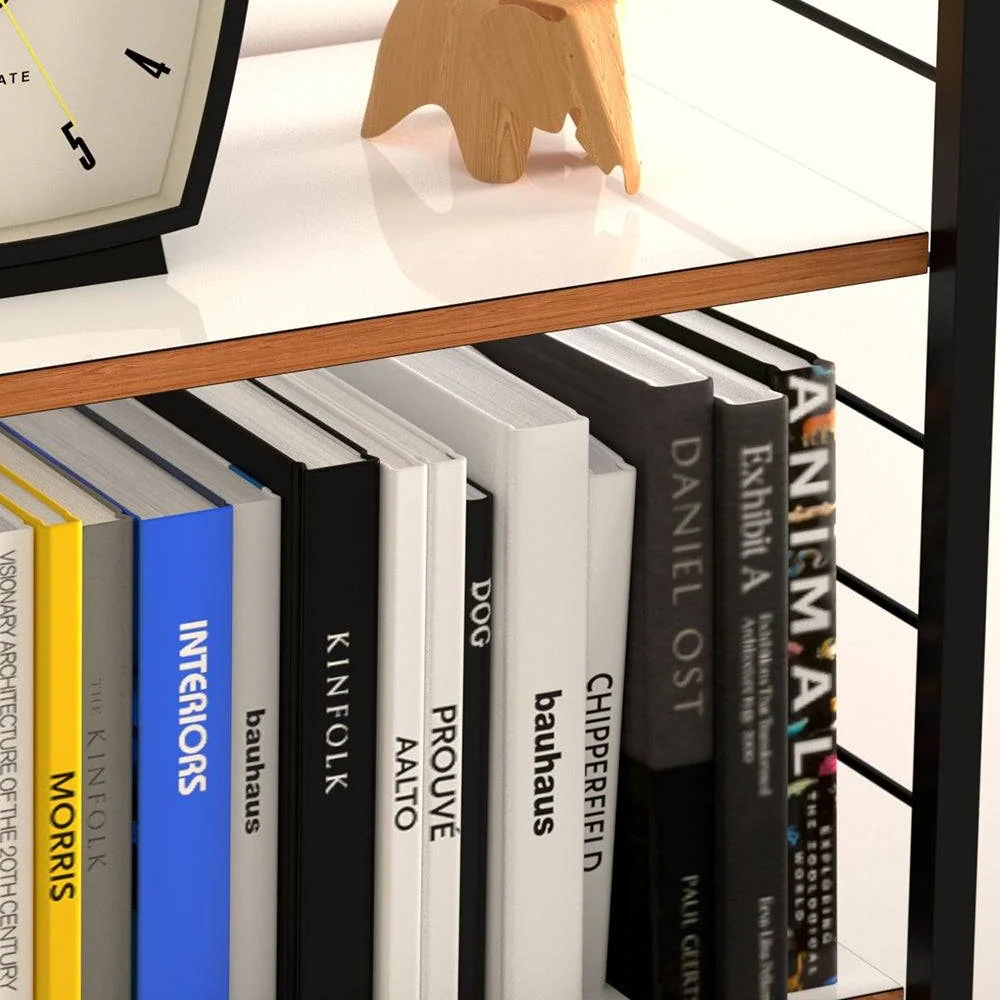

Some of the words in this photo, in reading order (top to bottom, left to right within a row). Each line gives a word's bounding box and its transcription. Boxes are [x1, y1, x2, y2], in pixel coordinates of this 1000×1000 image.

[124, 48, 172, 80] 4
[60, 121, 97, 171] 5
[670, 435, 704, 606] DANIEL
[738, 441, 774, 559] Exhibit
[469, 577, 492, 649] DOG
[738, 566, 773, 595] A
[788, 373, 834, 777] ANIMAL
[0, 640, 18, 776] ARCHITECTURE
[178, 619, 209, 797] INTERIORS
[325, 630, 351, 796] KINFOLK
[672, 628, 705, 717] OST
[0, 777, 18, 803] OF
[86, 729, 107, 872] KINFOLK
[244, 708, 266, 835] bauhaus
[393, 736, 419, 832] AALTO
[428, 703, 462, 842] PROUVÉ
[533, 688, 563, 837] bauhaus
[0, 803, 18, 843] THE
[49, 771, 77, 903] MORRIS
[805, 790, 819, 829] THE
[0, 846, 18, 901] 20TH
[679, 874, 700, 930] PAUL
[794, 851, 805, 922] WORLD
[0, 900, 18, 991] CENTURY
